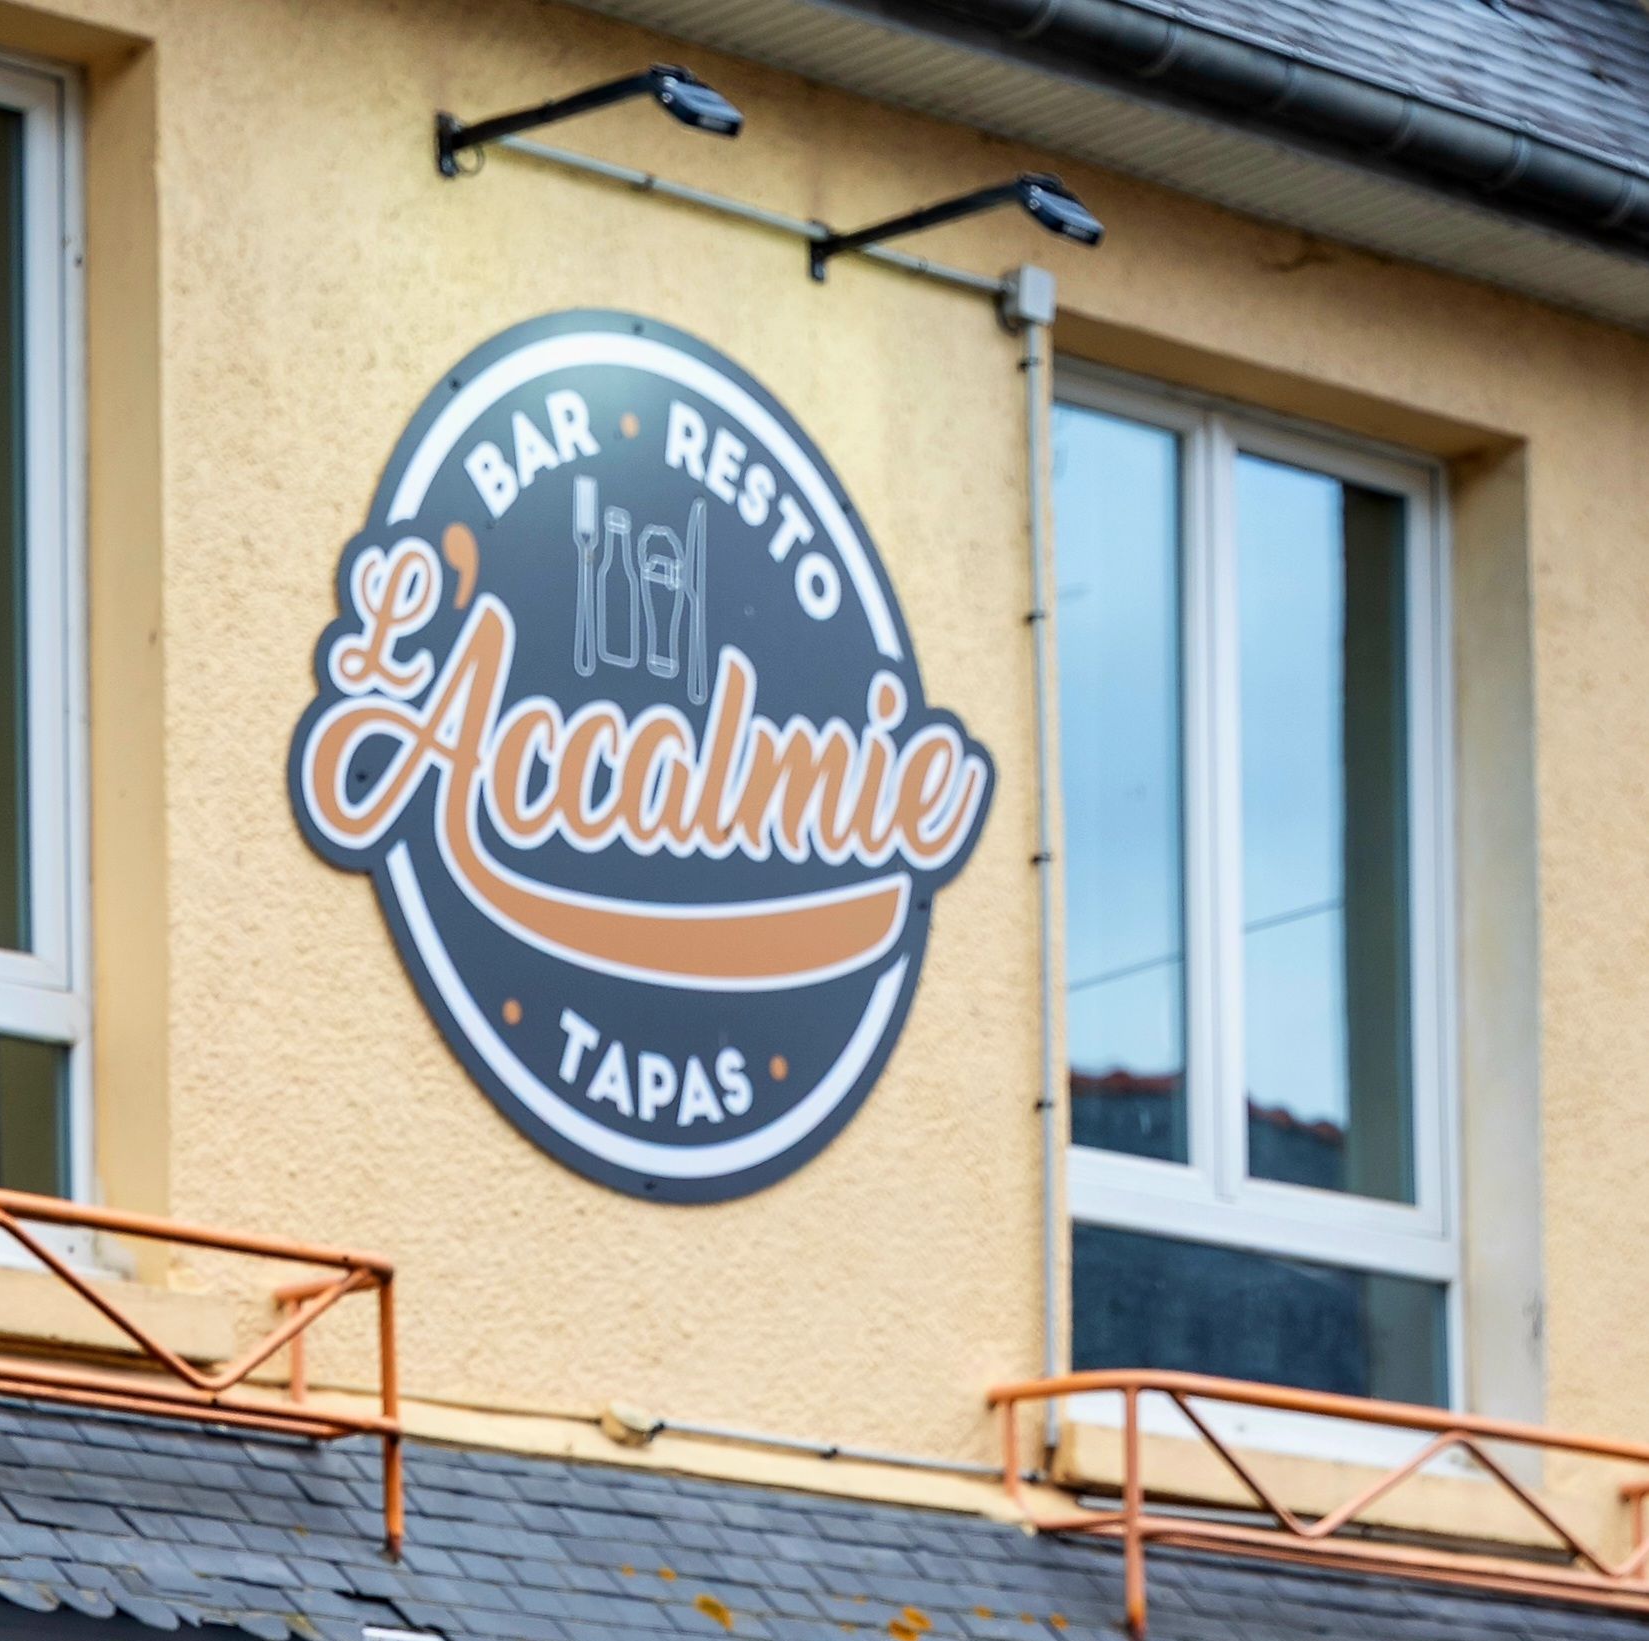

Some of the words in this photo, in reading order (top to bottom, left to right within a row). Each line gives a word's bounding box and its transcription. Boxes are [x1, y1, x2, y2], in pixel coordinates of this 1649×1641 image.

[463, 388, 602, 520] BAR
[664, 397, 844, 622] RESTO
[302, 521, 990, 991] L'Accalmie
[558, 1006, 752, 1127] TAPAS
